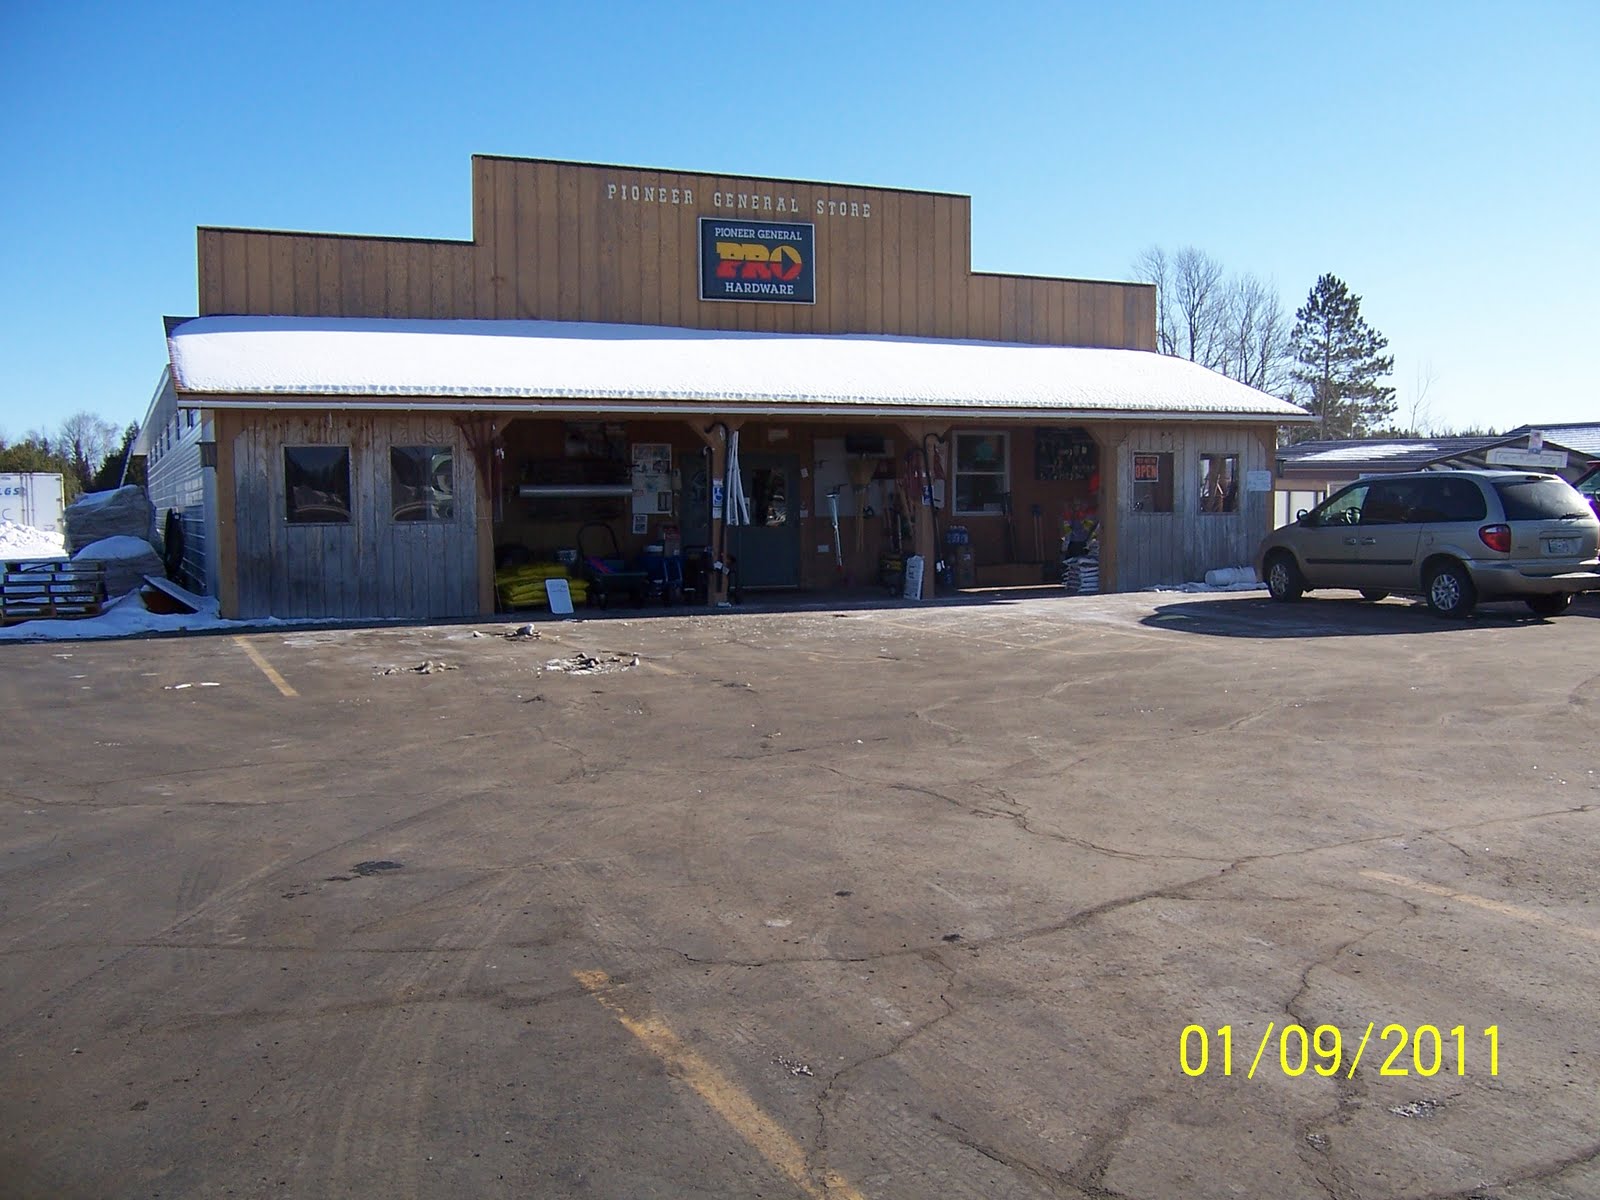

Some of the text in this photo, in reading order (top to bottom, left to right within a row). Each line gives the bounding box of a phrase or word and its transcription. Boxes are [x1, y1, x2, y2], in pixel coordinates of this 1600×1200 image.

[608, 184, 871, 218] PIONEER GENERAL STORE
[715, 227, 803, 241] PIONEER GENERAL
[716, 242, 803, 281] PRO
[725, 282, 794, 295] HARDWARE
[1135, 465, 1157, 479] OPEN
